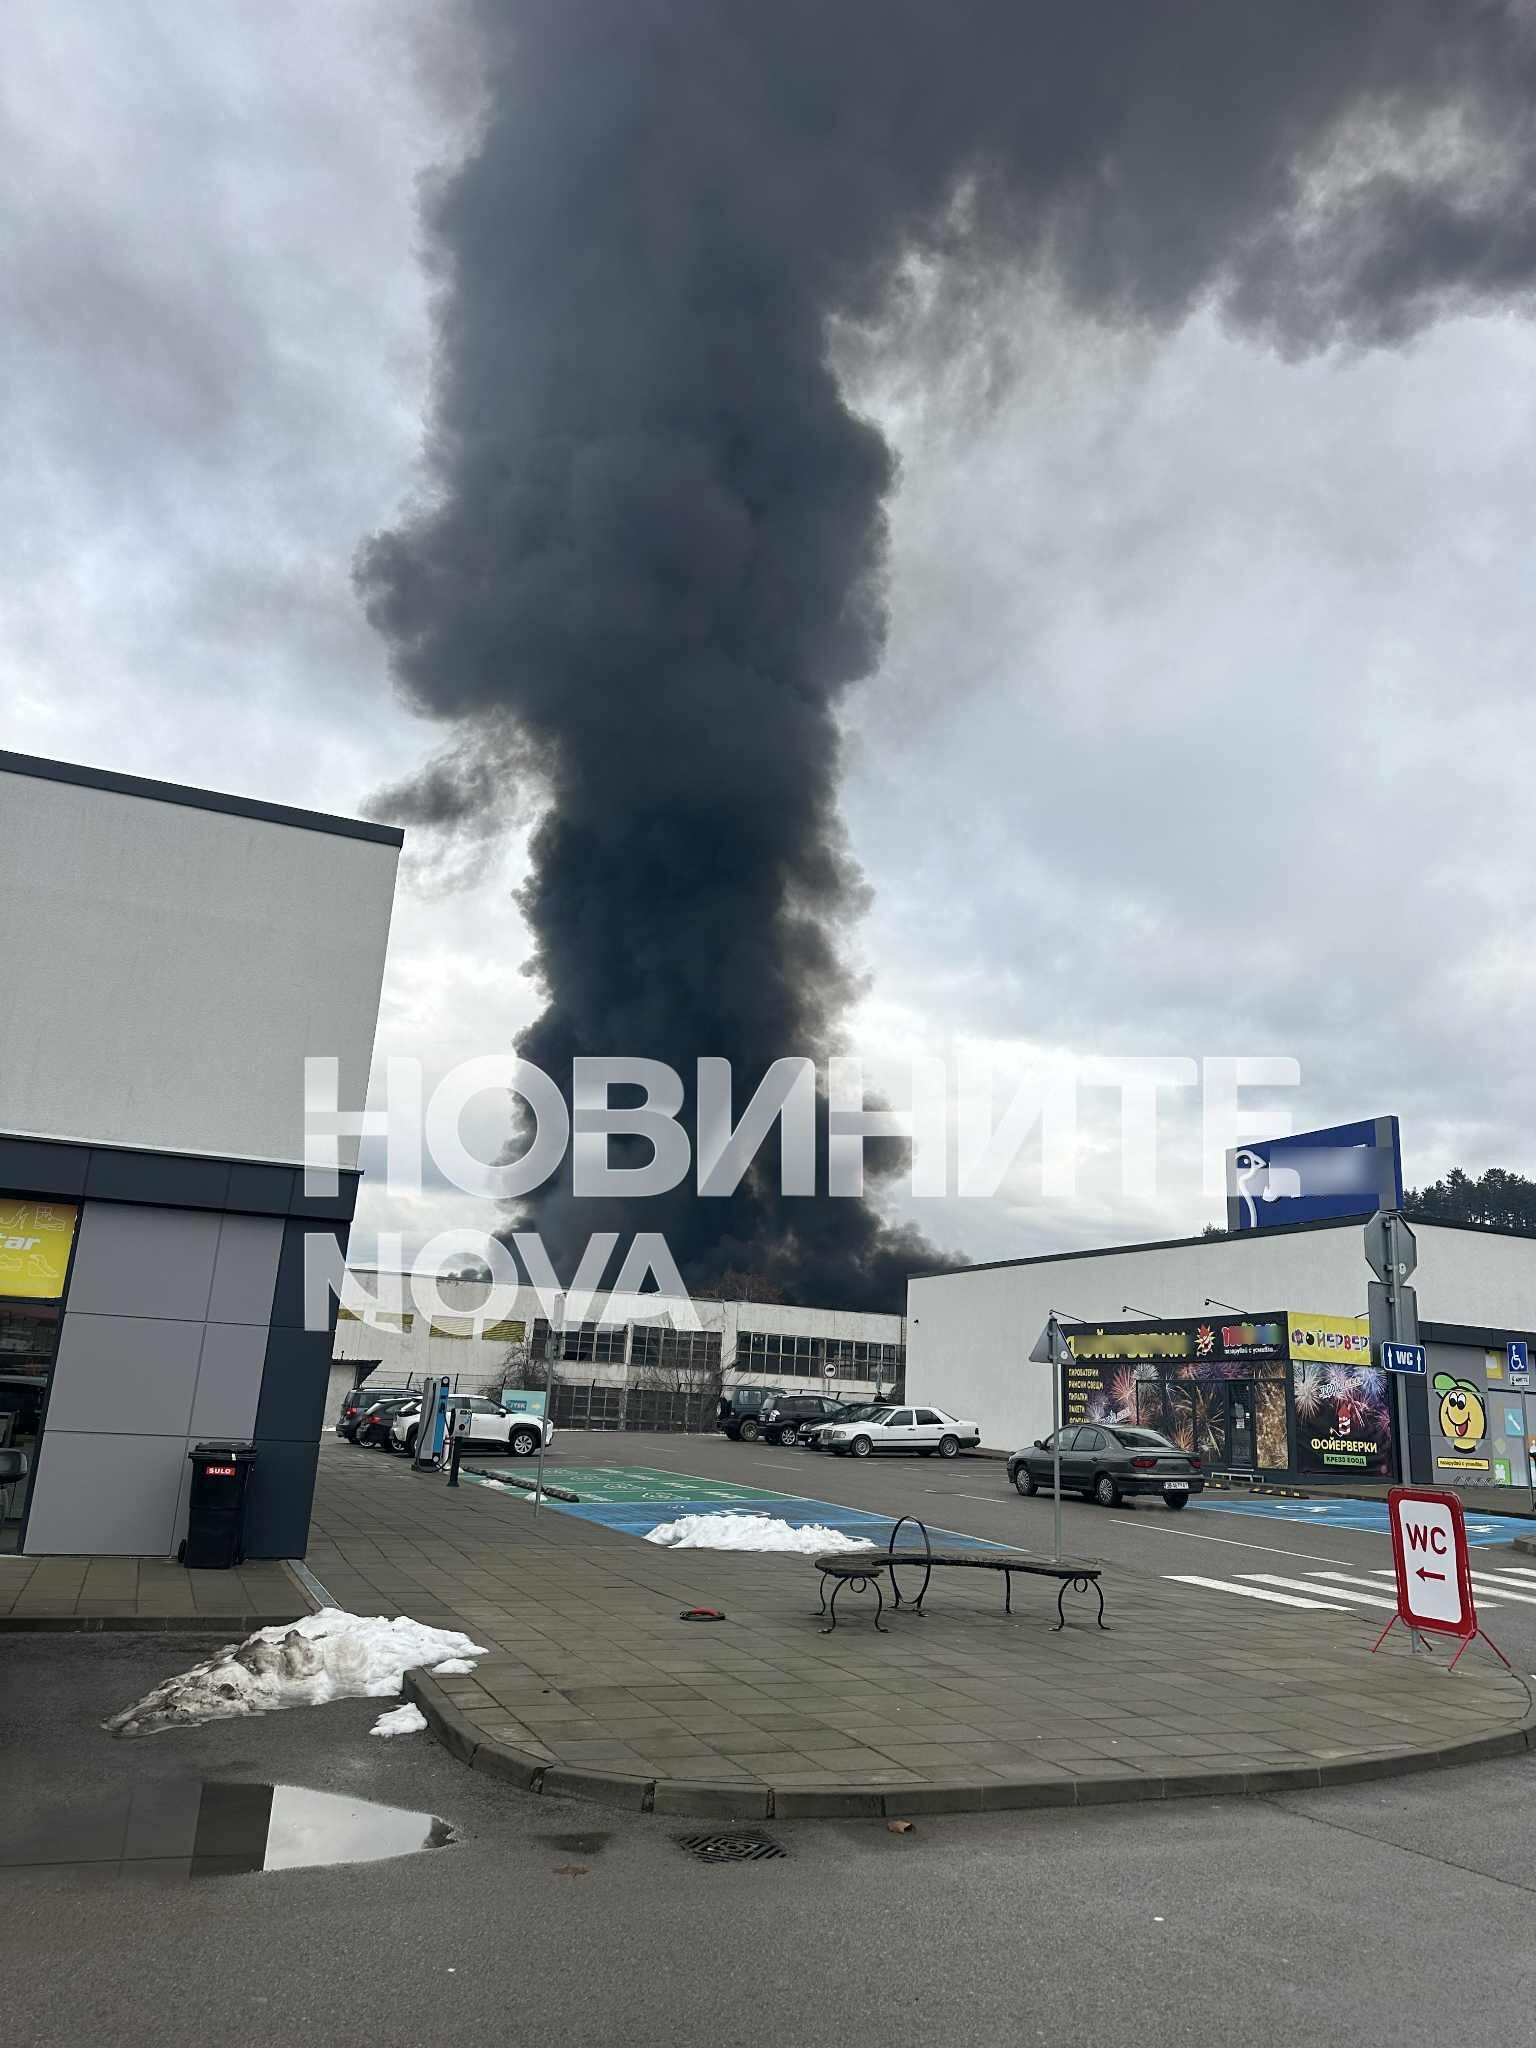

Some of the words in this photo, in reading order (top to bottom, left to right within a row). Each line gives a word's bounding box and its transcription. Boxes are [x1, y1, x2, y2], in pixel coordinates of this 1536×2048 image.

[1291, 1328, 1369, 1351] ФОЙЕРВЕР
[1395, 1350, 1414, 1366] WC
[1311, 1437, 1378, 1453] ФОЙЕРВЕРКИ
[1406, 1523, 1447, 1555] WC
